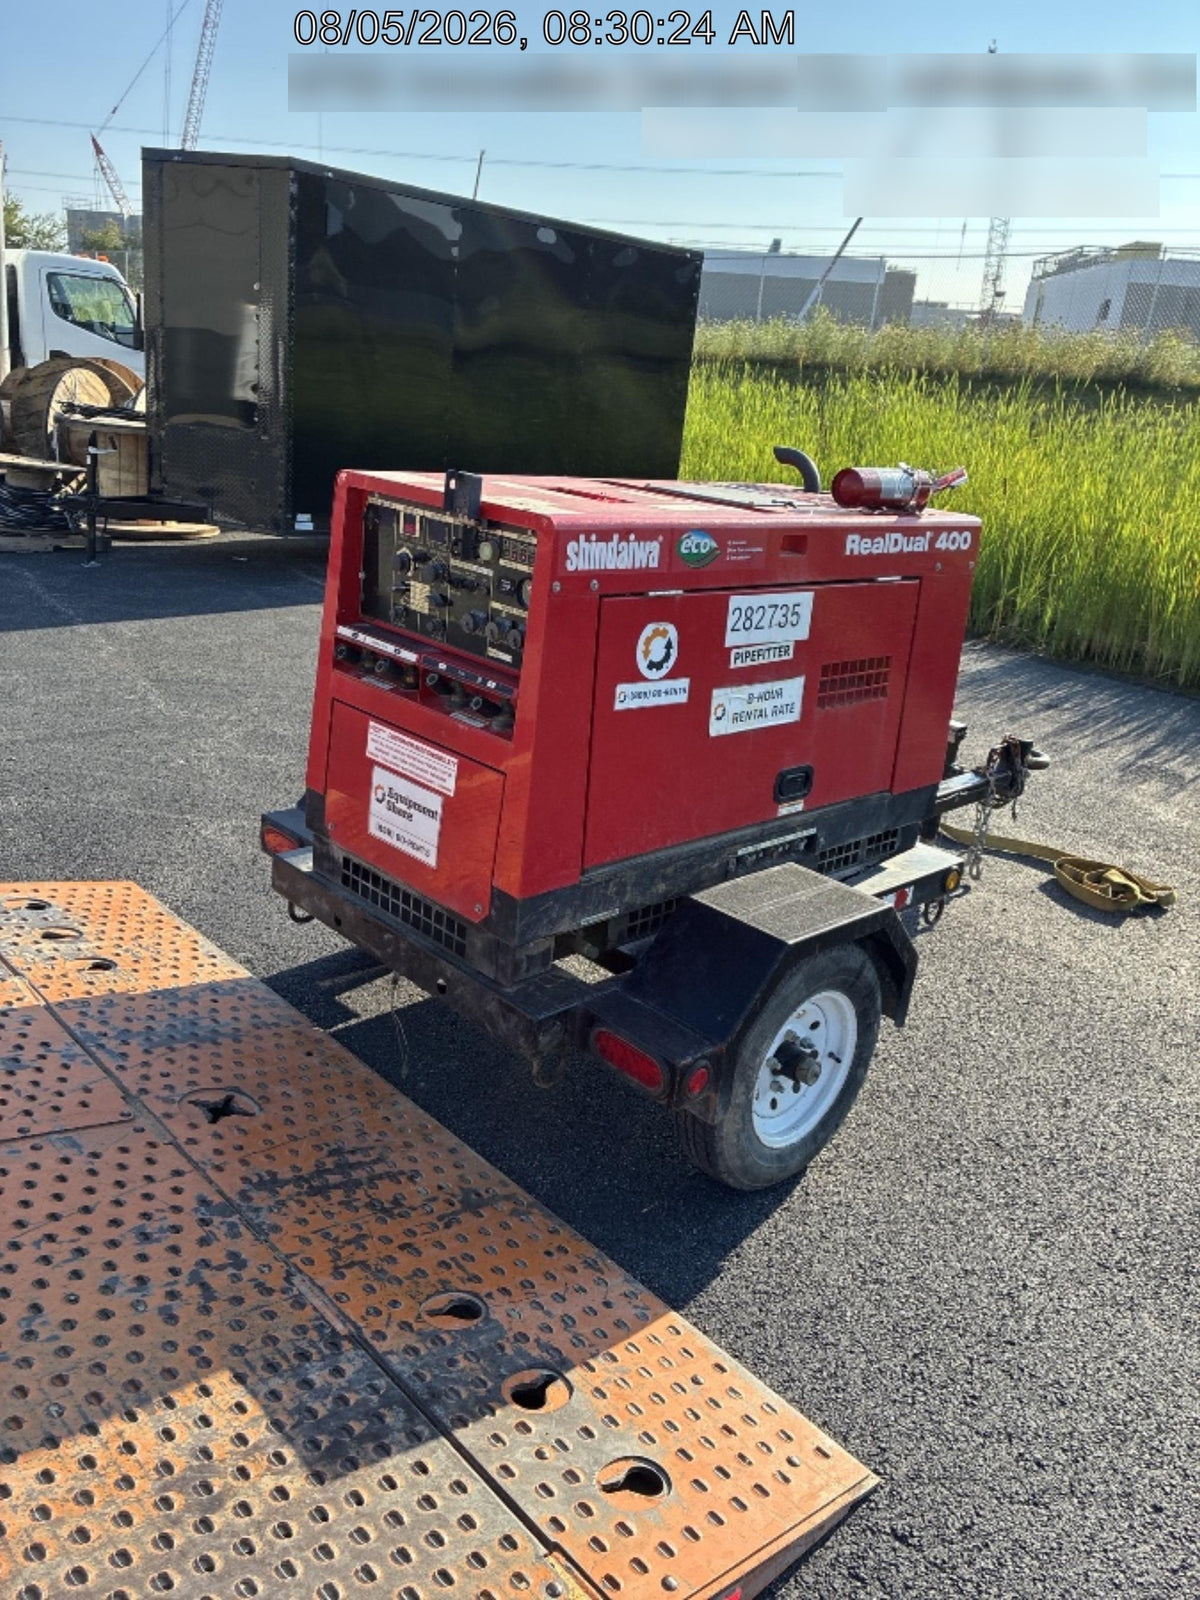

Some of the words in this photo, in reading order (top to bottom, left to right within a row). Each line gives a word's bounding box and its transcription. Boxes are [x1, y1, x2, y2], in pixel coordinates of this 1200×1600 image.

[566, 533, 660, 571] shindaiwa
[680, 538, 711, 554] eco
[845, 531, 930, 556] RealDual
[935, 531, 972, 550] 400
[730, 603, 802, 632] 282735
[733, 645, 791, 665] PIPEFITTER
[731, 707, 768, 724] RENTAL
[771, 702, 796, 719] RATE
[386, 787, 438, 822] Equipment
[386, 799, 414, 823] Share
